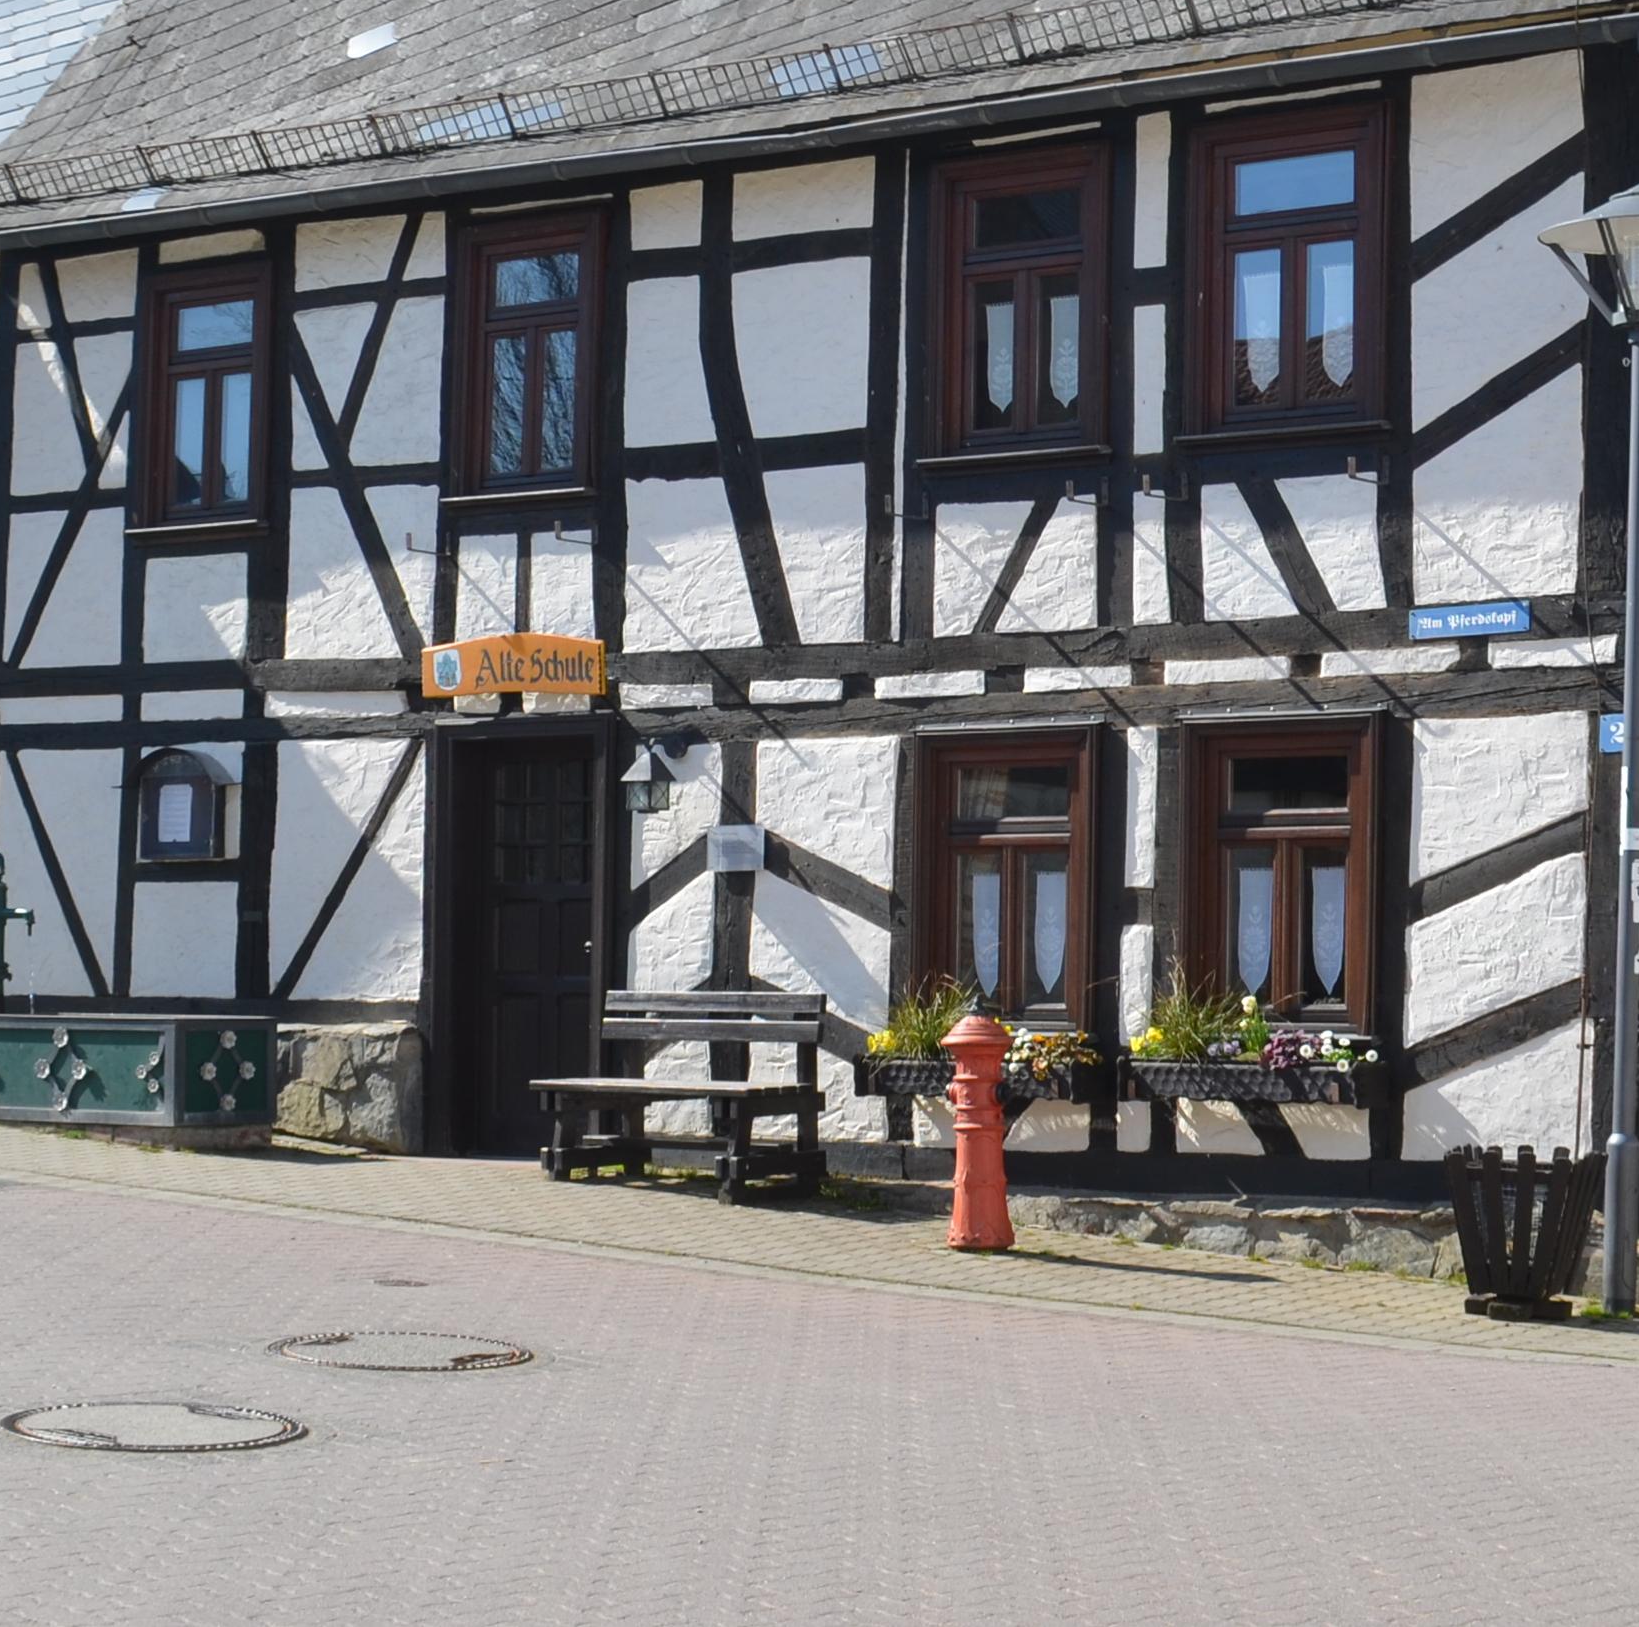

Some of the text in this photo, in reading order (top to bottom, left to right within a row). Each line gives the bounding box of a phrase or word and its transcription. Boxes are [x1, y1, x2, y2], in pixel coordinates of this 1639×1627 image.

[1418, 609, 1517, 630] Am Pferdskopf
[474, 648, 595, 690] Alte Schule
[1610, 722, 1624, 743] 2
